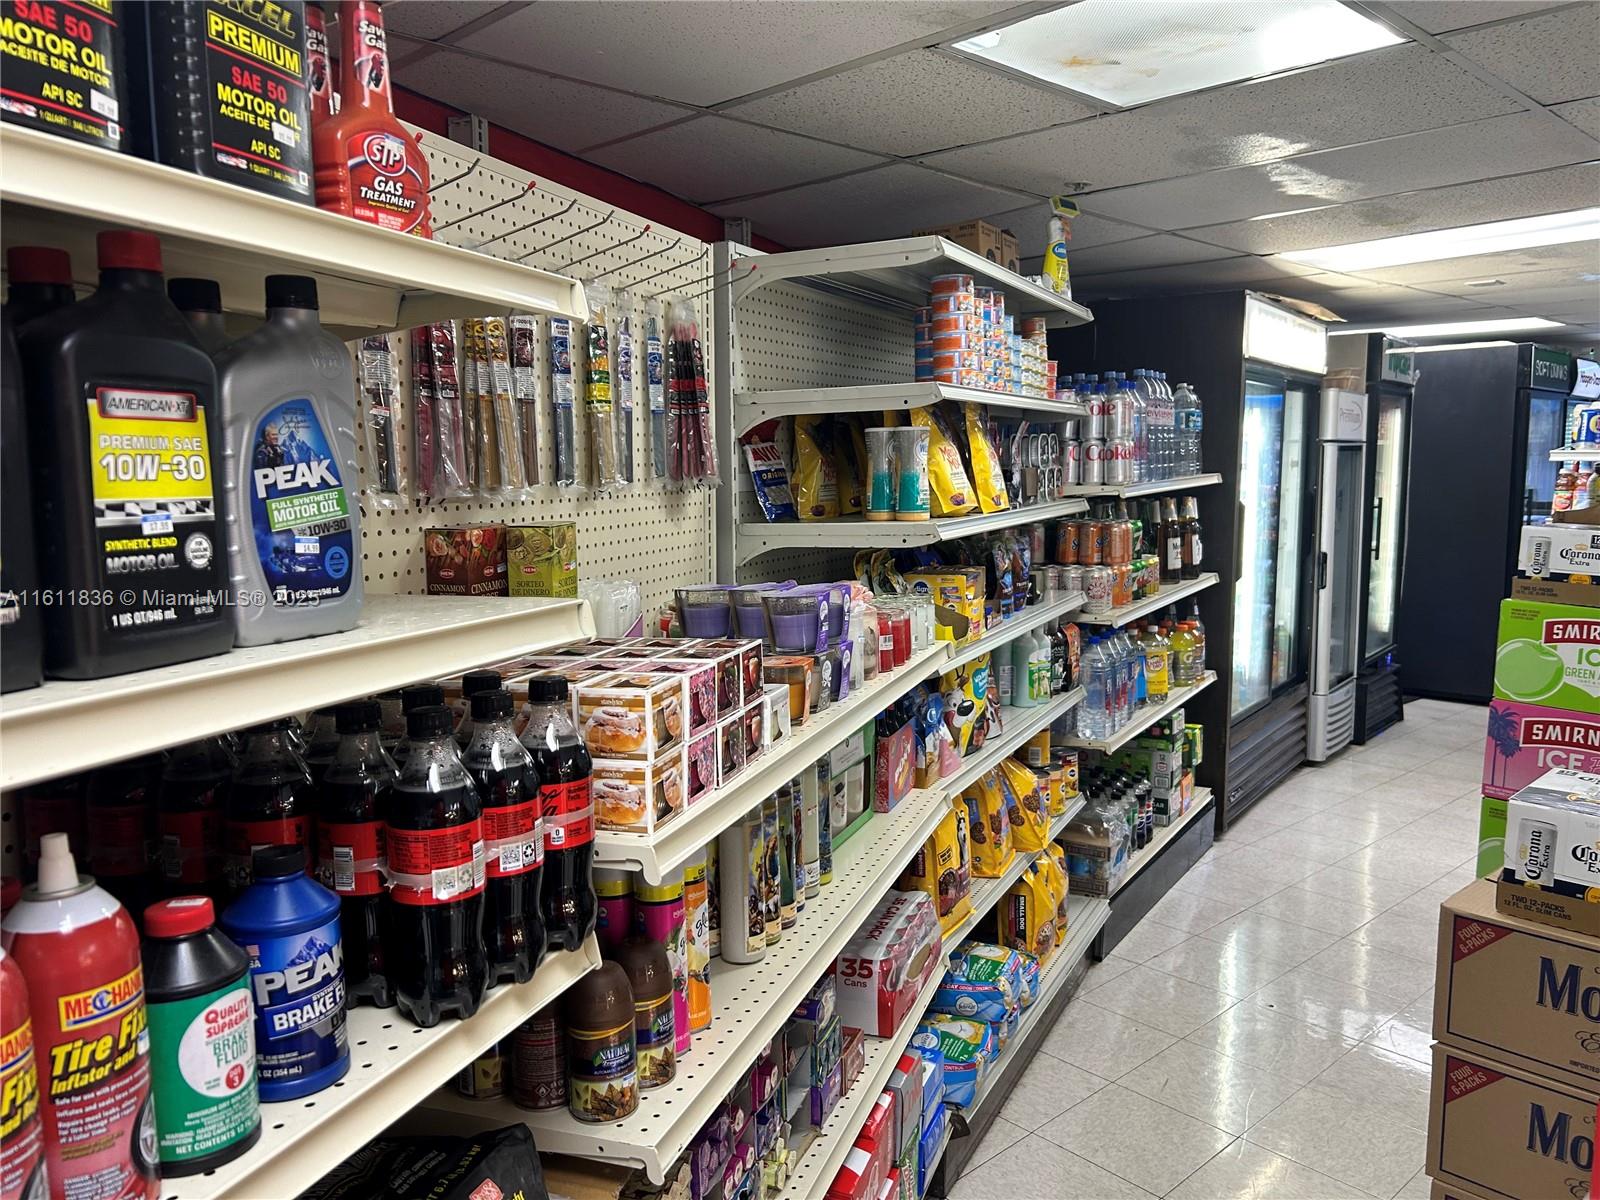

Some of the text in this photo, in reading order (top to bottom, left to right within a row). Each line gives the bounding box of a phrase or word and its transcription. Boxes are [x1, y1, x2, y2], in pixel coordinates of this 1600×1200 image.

[14, 0, 93, 44] SAE 50
[0, 16, 112, 76] MOTOR OIL
[210, 13, 301, 74] PREMIUM
[0, 38, 111, 88] ACEITE DE MOTOR
[42, 81, 64, 103] API
[65, 88, 84, 109] SC
[231, 66, 288, 105] SAE 50
[216, 82, 302, 131] MOTOR OIL
[219, 103, 271, 131] ACEITE DE
[250, 139, 281, 161] API SC
[370, 141, 401, 168] STP
[360, 186, 416, 210] TREATMENT
[373, 175, 404, 195] GAS
[98, 433, 203, 452] PREMIUM SAE
[99, 452, 207, 482] 10W-30
[253, 457, 340, 500] PEAK
[271, 491, 339, 511] FULL SYNTHETIC
[273, 502, 319, 523] MOTOR
[319, 499, 341, 514] OIL
[307, 518, 347, 537] 10W-30
[104, 536, 178, 553] SYNTHETIC BLEND
[105, 552, 180, 574] MOTOR OIL
[1531, 542, 1543, 575] Corona
[1567, 557, 1590, 567] Extra
[429, 583, 467, 593] CINNAMON
[511, 587, 551, 597] DE DINERO
[515, 580, 546, 589] SORTEO
[1565, 665, 1596, 680] GREEN
[1537, 748, 1585, 770] ICE
[1524, 829, 1551, 881] Corona Extra
[1511, 894, 1565, 913] TWO 12-PACKS
[1553, 910, 1572, 921] CANS
[1457, 921, 1482, 941] FOUR
[1458, 926, 1497, 954] 6-PACKS
[254, 938, 344, 1006] PEAK
[840, 957, 874, 979] 35
[843, 977, 868, 988] Cans
[204, 995, 249, 1025] QUALITY
[272, 996, 335, 1032] BRAKE
[205, 1009, 250, 1039] SUPREME
[213, 1027, 248, 1056] BRAKE
[216, 1038, 248, 1068] FLUID
[51, 1034, 114, 1077] Tire
[51, 1062, 113, 1095] Inflator
[113, 1042, 137, 1072] and
[1450, 1064, 1474, 1084] FOUR
[1450, 1070, 1488, 1096] 6-PACKS
[175, 1144, 193, 1155] NET
[193, 1131, 235, 1151] CONTENTS
